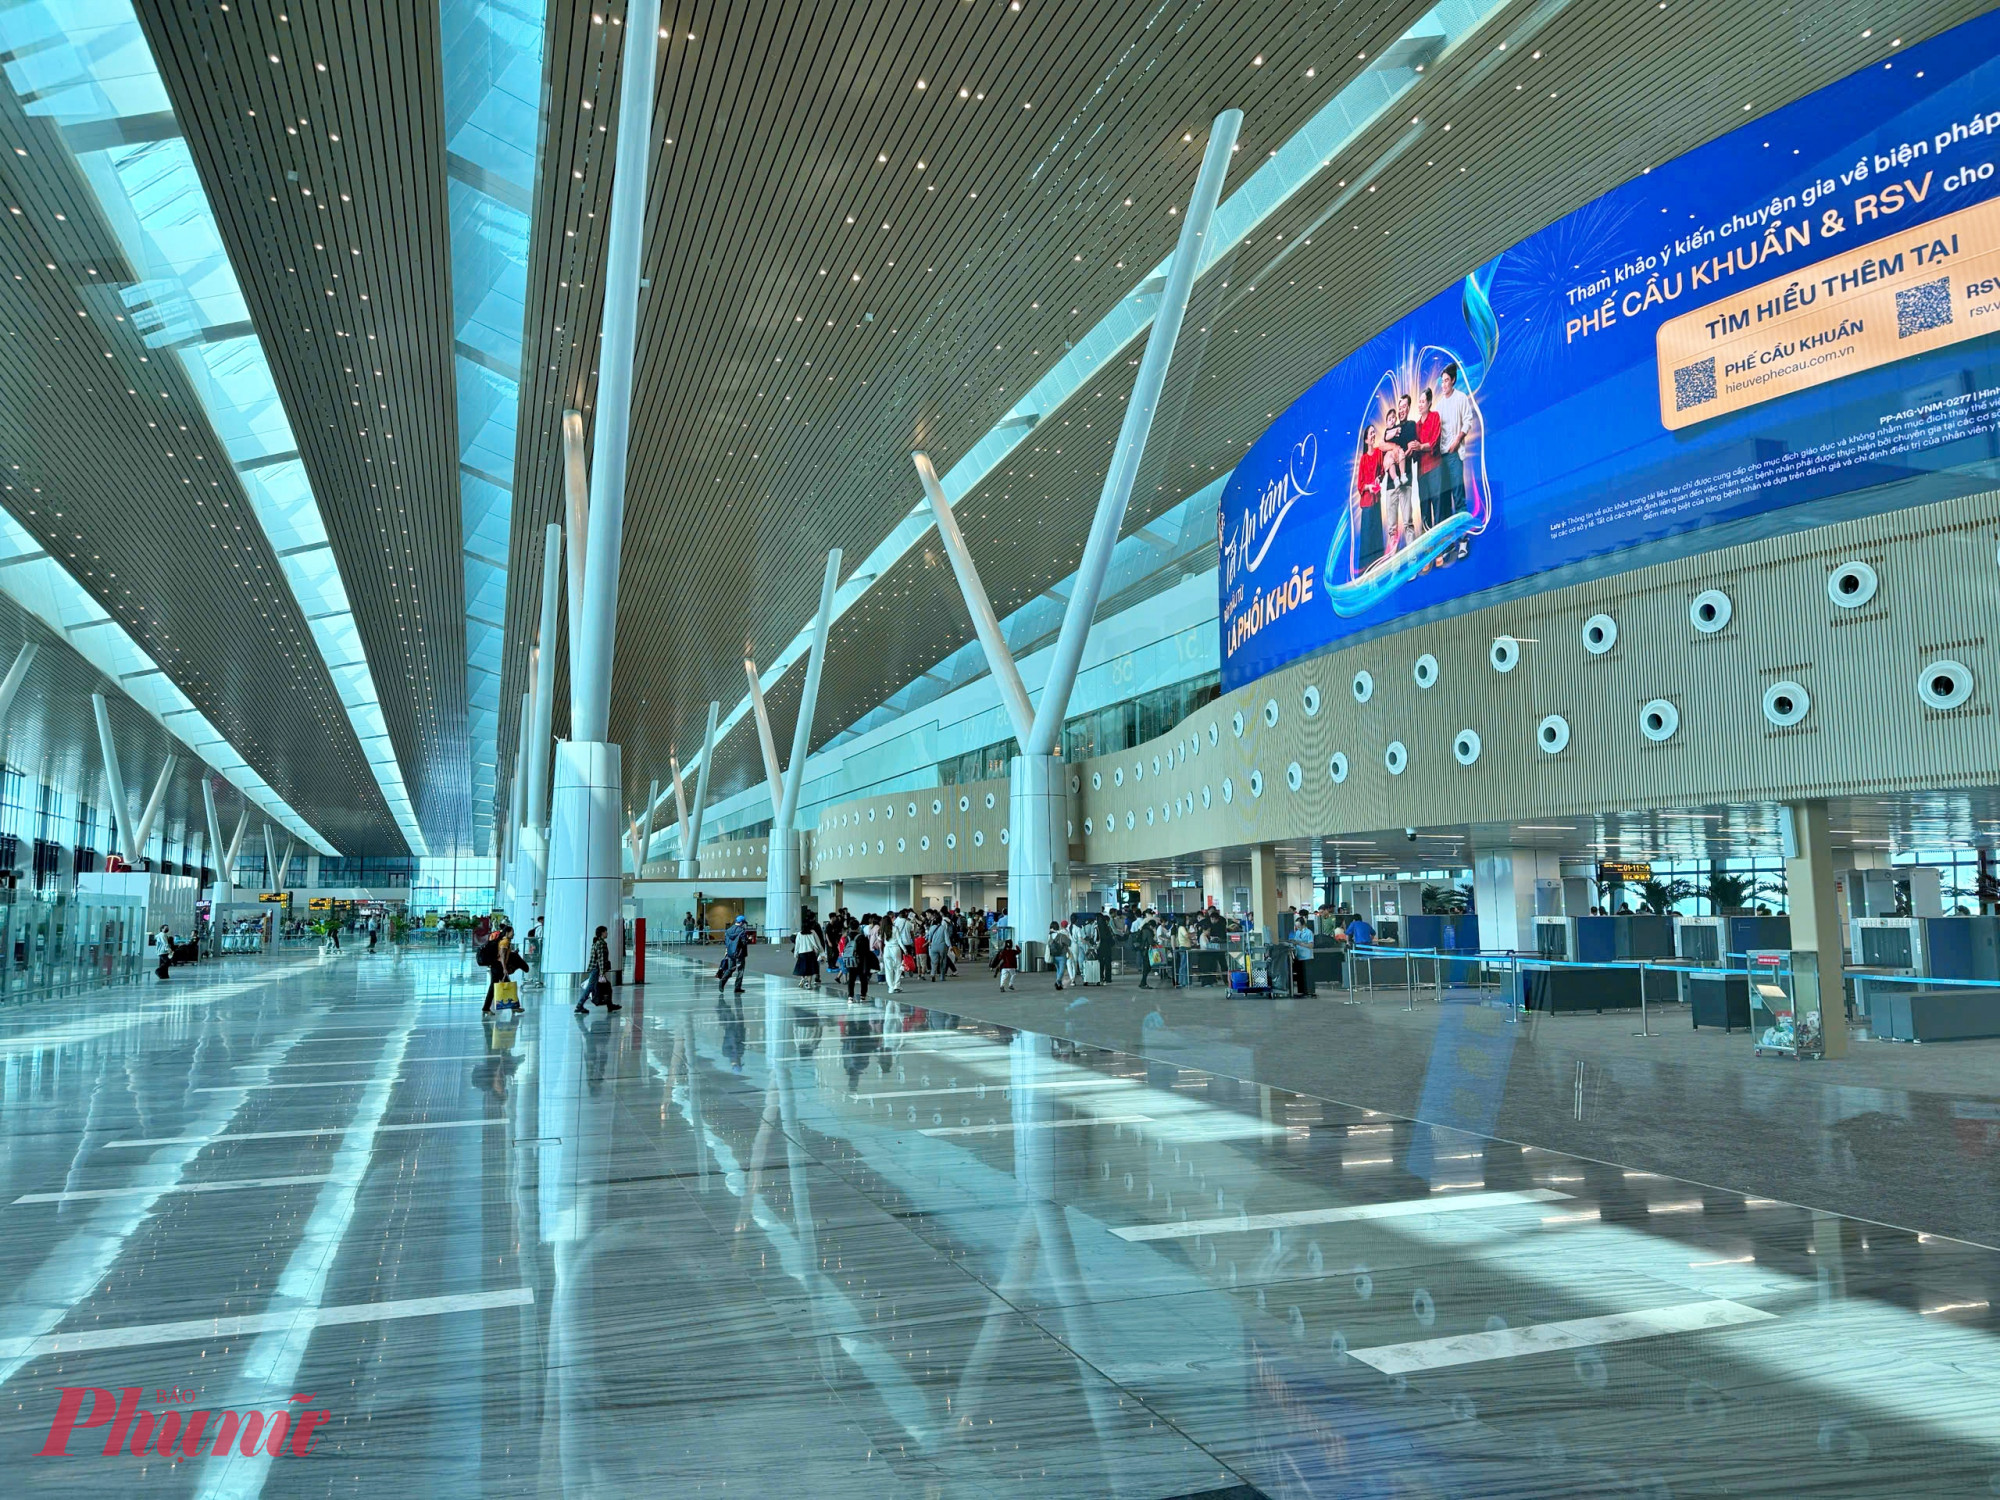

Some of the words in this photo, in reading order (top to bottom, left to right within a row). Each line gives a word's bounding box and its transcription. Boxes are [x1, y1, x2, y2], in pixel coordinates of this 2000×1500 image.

[1566, 276, 1611, 305] Tham
[1614, 256, 1656, 284] khảo
[1660, 244, 1670, 266] ý
[1675, 226, 1714, 256] kiến
[1720, 196, 1796, 237] chuyên
[1802, 179, 1836, 208] gia
[1840, 156, 1868, 186] về
[1874, 140, 1928, 174] biện
[1935, 112, 2000, 154] pháp
[1566, 290, 1618, 344] PHẾ
[1622, 272, 1682, 317] CẦU
[1692, 220, 1810, 290] KHUẨN
[1820, 209, 1846, 238] &
[1854, 170, 1933, 226] RSV
[1944, 162, 1994, 192] cho
[1705, 309, 1750, 340] TÌM
[1757, 282, 1816, 322] HIỂU
[1822, 252, 1904, 296] THÊM
[1910, 234, 1959, 266] TẠI
[1725, 350, 1757, 378] PHẾ
[1760, 342, 1794, 364] CẦU
[1726, 345, 1854, 394] hieuvephecau.com.vn
[1880, 394, 1971, 424] PP-A1G-VNM-0277
[1990, 424, 1996, 433] y
[1630, 497, 1646, 506] trong
[1713, 472, 1731, 482] cung
[1748, 462, 1762, 472] cho
[1948, 406, 1969, 418] thay
[1672, 494, 1688, 504] quan
[1928, 426, 1942, 436] gia
[1260, 473, 1288, 530] tâm
[1228, 616, 1237, 660] LÁ
[1238, 586, 1264, 647] PHỔI
[1266, 565, 1314, 626] KHỎE
